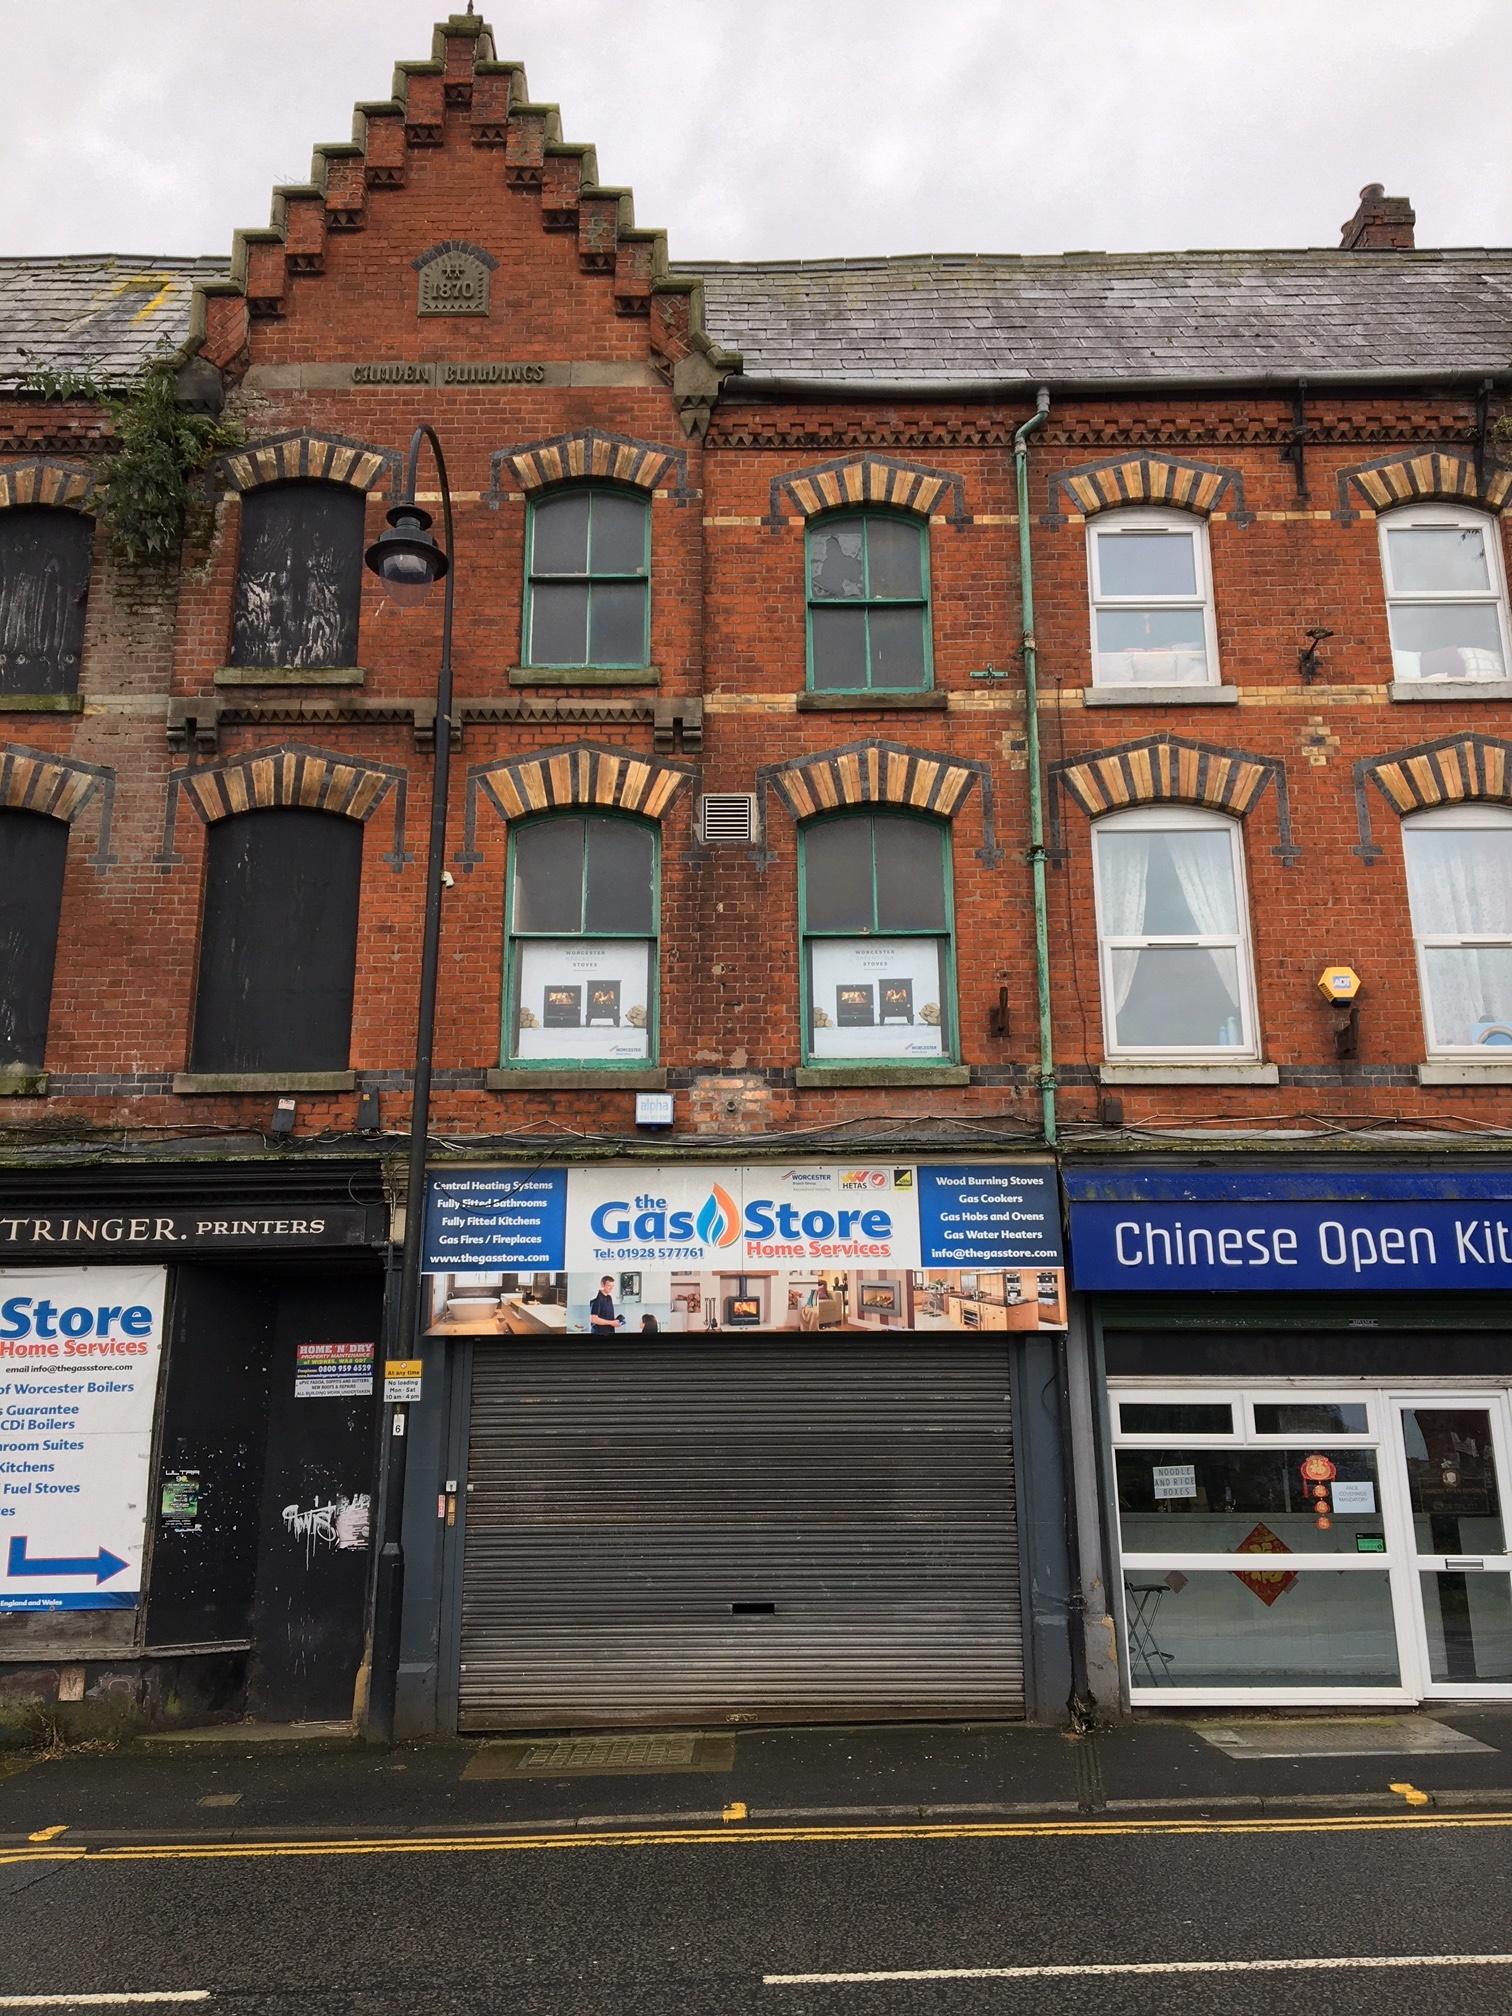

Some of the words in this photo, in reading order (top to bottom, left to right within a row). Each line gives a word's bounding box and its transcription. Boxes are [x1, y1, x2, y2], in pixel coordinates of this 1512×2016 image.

[431, 281, 474, 298] 1870
[352, 365, 429, 384] CAMDEN
[444, 365, 545, 383] BUILDINGS
[640, 1098, 669, 1114] alpha
[433, 1181, 470, 1190] Central
[471, 1181, 511, 1191] Heating
[512, 1181, 553, 1192] Systems
[936, 1177, 966, 1186] Wood
[968, 1176, 1008, 1187] Burning
[1010, 1176, 1044, 1185] Stoves
[437, 1199, 460, 1209] Fully
[462, 1199, 491, 1208] Fitted
[493, 1198, 547, 1208] Bathrooms
[634, 1194, 667, 1209] the
[959, 1194, 979, 1203] Gas
[980, 1194, 1023, 1203] Cookers
[442, 1217, 465, 1228] Fully
[467, 1216, 496, 1226] Fitted
[498, 1216, 541, 1226] Kitchens
[590, 1201, 697, 1242] Gas
[743, 1199, 893, 1240] Store
[940, 1212, 960, 1221] Gas
[962, 1212, 988, 1221] Hobs
[990, 1212, 1010, 1221] and
[1011, 1212, 1045, 1221] Ovens
[195, 1220, 325, 1235] PRINTERS
[438, 1235, 459, 1244] Gas
[460, 1235, 484, 1244] Fires
[485, 1235, 491, 1244] /
[492, 1234, 542, 1246] Fireplaces
[944, 1230, 964, 1239] Gas
[965, 1230, 999, 1239] Water
[1001, 1230, 1043, 1239] Heaters
[746, 1241, 804, 1257] Home
[808, 1239, 890, 1256] Services
[1115, 1221, 1298, 1266] Chinese
[1318, 1220, 1437, 1273] Open
[430, 1253, 550, 1265] www.thegasstore.com
[593, 1248, 614, 1259] Tel:
[617, 1248, 655, 1259] 01928
[658, 1247, 705, 1259] 577761
[931, 1248, 1058, 1260] info@thegasstore.com
[0, 1296, 153, 1340] Store
[0, 1340, 60, 1358] Home
[63, 1337, 148, 1356] Services
[300, 1345, 333, 1354] HOME
[349, 1344, 373, 1352] DRY
[5, 1365, 30, 1373] email
[30, 1363, 133, 1373] info@thegassstore.com
[14, 1383, 84, 1395] Worcester
[87, 1381, 135, 1393] Boilers
[6, 1404, 80, 1416] Guarantee
[0, 1420, 25, 1431] CDi
[27, 1418, 75, 1430] Boilers
[395, 1425, 401, 1433] 6
[0, 1442, 39, 1452] room
[42, 1439, 84, 1451] Suites
[1158, 1468, 1190, 1476] NOODLE
[3, 1483, 32, 1494] Fuel
[34, 1482, 81, 1494] Stoves
[1155, 1479, 1170, 1487] AND
[1173, 1477, 1194, 1485] RICE
[1163, 1488, 1190, 1496] BOXES
[0, 1600, 27, 1608] England
